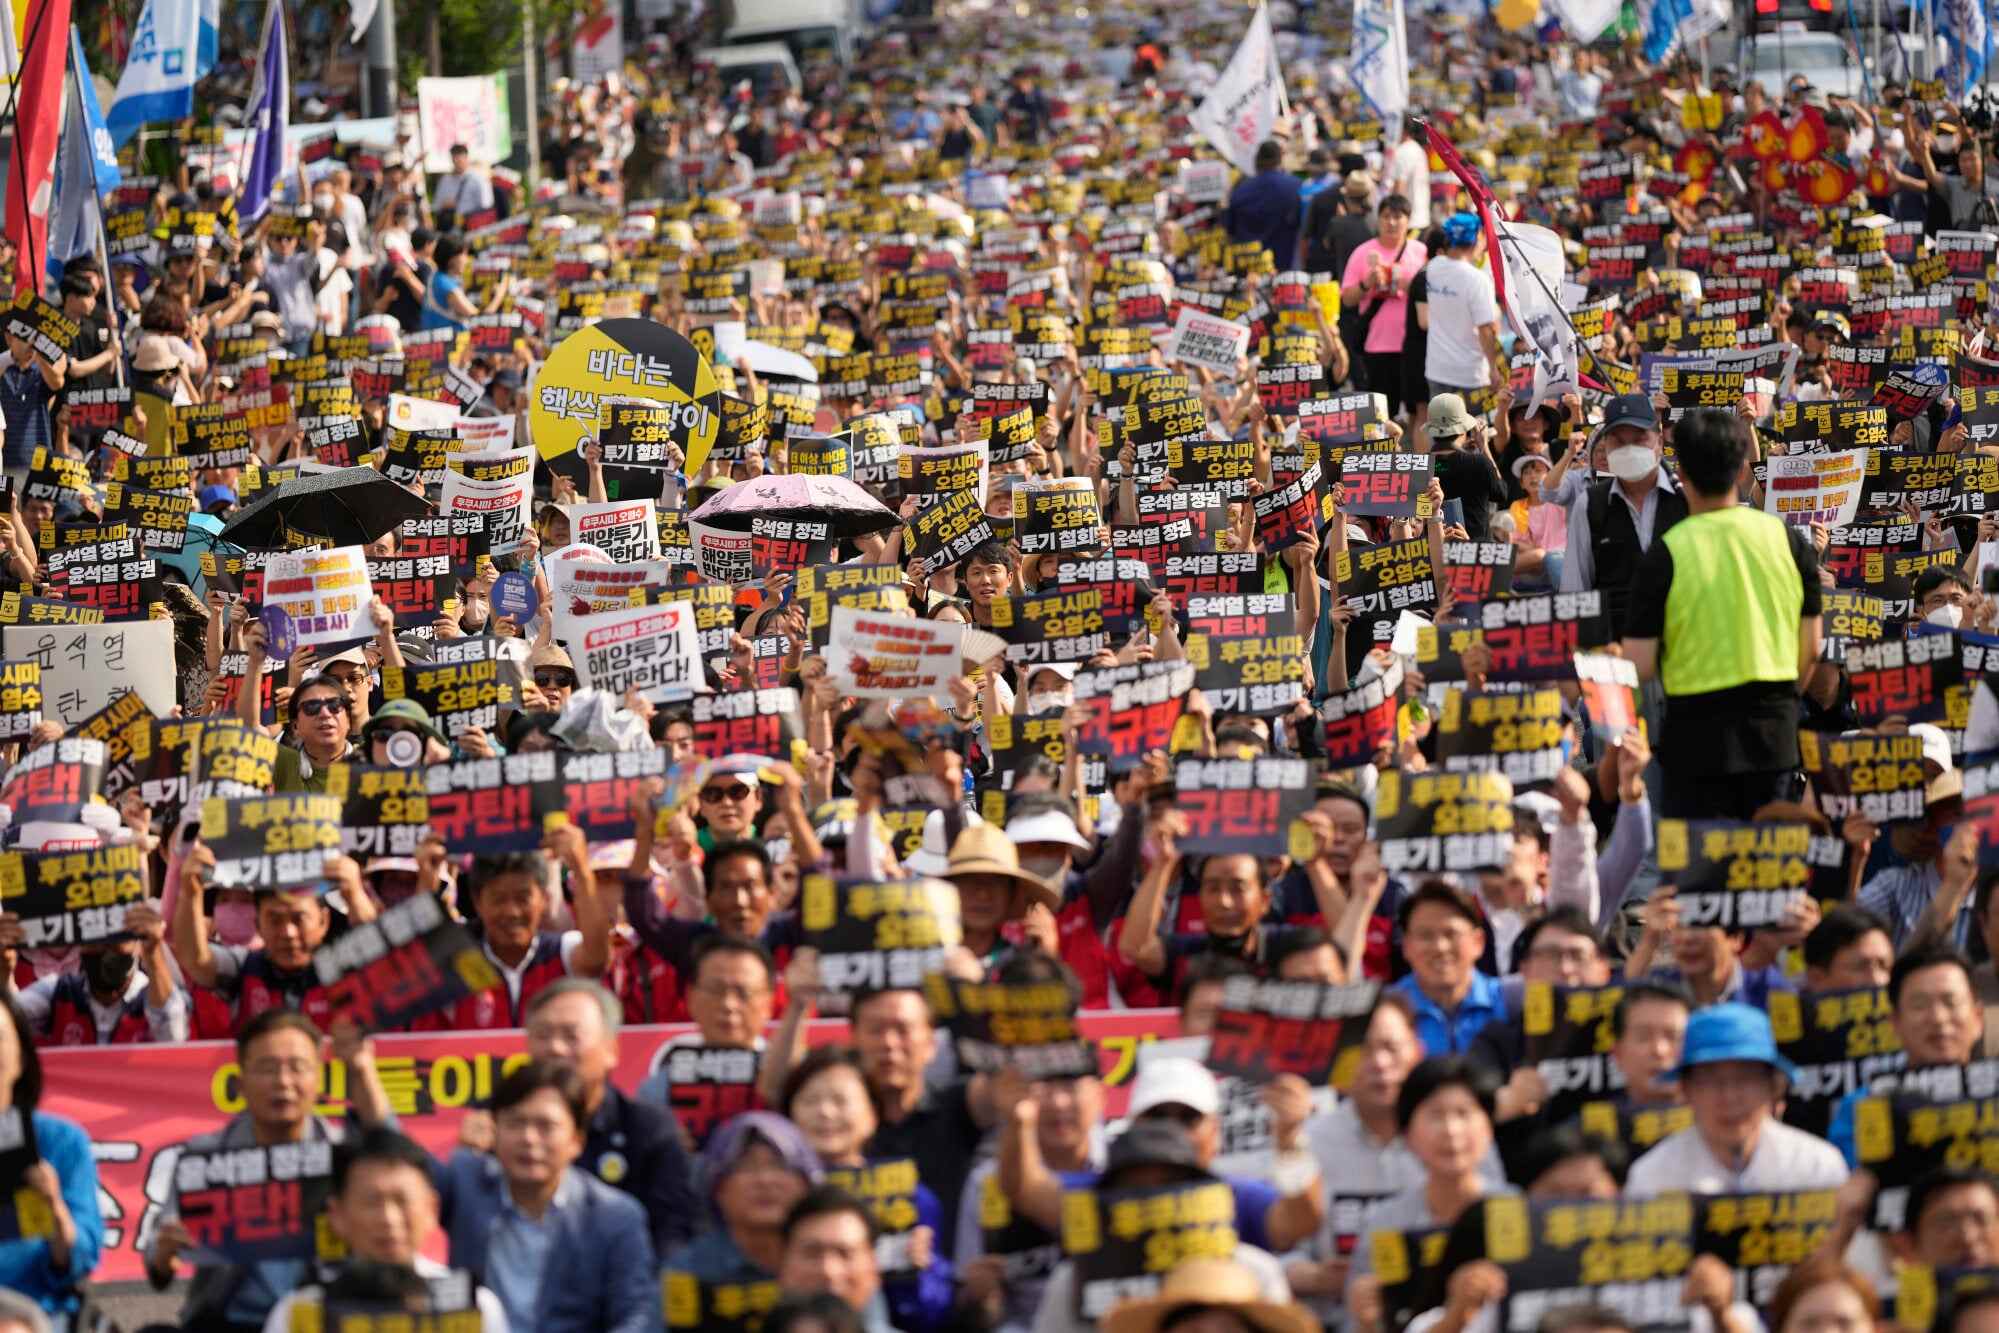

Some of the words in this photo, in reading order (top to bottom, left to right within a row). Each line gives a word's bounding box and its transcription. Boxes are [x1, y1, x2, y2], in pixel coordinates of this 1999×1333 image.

[587, 349, 673, 388] 바다는
[974, 384, 1015, 400] 윤석열
[1017, 382, 1046, 399] 정권
[1686, 372, 1744, 389] 후쿠시마
[1299, 398, 1340, 416] 윤석열
[1341, 394, 1370, 411] 정권
[1699, 388, 1742, 405] 오염수
[540, 386, 709, 437] 핵쓰이
[619, 408, 671, 424] 후쿠시마
[1148, 399, 1203, 423] 후쿠시마
[1839, 407, 1888, 429] 후쿠시마
[196, 417, 247, 438] 후쿠시마
[330, 423, 360, 442] 정권
[631, 425, 670, 443] 오염수
[1164, 418, 1207, 437] 오염수
[1299, 410, 1358, 438] 규탄!
[209, 434, 248, 451] 오염수
[414, 437, 464, 454] 후쿠시마
[1855, 427, 1888, 445] 오염수
[604, 445, 633, 463] 투기
[921, 452, 979, 476] 후쿠시마
[1192, 442, 1255, 464] 후쿠시마
[1342, 454, 1392, 473] 윤석열
[1395, 453, 1430, 472] 정권
[1889, 455, 1957, 471] 후쿠시마
[137, 456, 188, 476] 후쿠시마
[386, 464, 418, 485] 투기
[473, 460, 530, 482] 후쿠시마
[1207, 463, 1254, 479] 오염수
[936, 470, 978, 491] 오염수
[1342, 473, 1410, 505] 규탄!
[1904, 472, 1954, 489] 오염수
[131, 491, 192, 513] 후쿠시마
[1035, 493, 1097, 514] 후쿠시마
[1139, 492, 1187, 512] 윤석열
[1190, 490, 1222, 509] 정권
[1254, 481, 1303, 517] 윤석열
[1869, 491, 1906, 509] 투기
[142, 511, 187, 531] 오염수
[919, 489, 976, 535] 후쿠시마
[1052, 511, 1098, 529] 오염수
[64, 522, 128, 545] 후쿠시마
[402, 519, 450, 538] 윤석열
[452, 515, 484, 535] 정권
[752, 518, 792, 536] 윤석열
[795, 522, 829, 541] 정권
[938, 508, 983, 543] 오염수
[1112, 528, 1160, 548] 윤석열
[1162, 518, 1193, 542] 정권
[1830, 527, 1883, 545] 윤석열
[1886, 523, 1919, 543] 정권
[145, 527, 184, 549] 철회!
[921, 548, 955, 576] 투기
[951, 520, 993, 555] 철회!
[1021, 533, 1056, 553] 투기
[48, 540, 98, 571] 윤석열
[100, 538, 135, 561] 정권
[702, 547, 752, 570] 해양투
[752, 538, 809, 569] 규탄!
[1166, 555, 1217, 577] 윤석열
[1221, 552, 1258, 574] 정권
[1359, 537, 1430, 571] 후쿠시마
[1479, 542, 1514, 565] 정권
[69, 562, 120, 585] 윤석열
[122, 559, 156, 581] 정권
[366, 561, 413, 581] 윤석열
[416, 555, 450, 577] 정권
[825, 566, 902, 589] 후쿠시마
[1058, 561, 1114, 582] 윤석열
[1378, 563, 1434, 588] 오염수
[69, 582, 141, 617] 규탄!
[1023, 589, 1102, 619] 후쿠시마
[1188, 596, 1244, 617] 윤석열
[1247, 594, 1287, 614] 정권
[1389, 581, 1436, 609] 철회!
[30, 604, 104, 624] 후쿠시마
[1483, 596, 1551, 629] 윤석열
[1553, 589, 1602, 619] 정권
[1044, 615, 1103, 637] 오염수
[1831, 615, 1883, 639] 오염수
[26, 631, 126, 671] 윤석열
[587, 631, 681, 677] 해양투기
[1220, 635, 1304, 664] 후쿠시마
[1906, 631, 1954, 665] 정권
[416, 659, 497, 692] 후쿠시마
[1240, 660, 1304, 684] 오염수
[437, 685, 499, 713] 오염수
[1850, 663, 1933, 715] 규탄!
[692, 691, 756, 719] 윤석열
[693, 714, 782, 757] 규탄!
[429, 784, 533, 840] 규탄!
